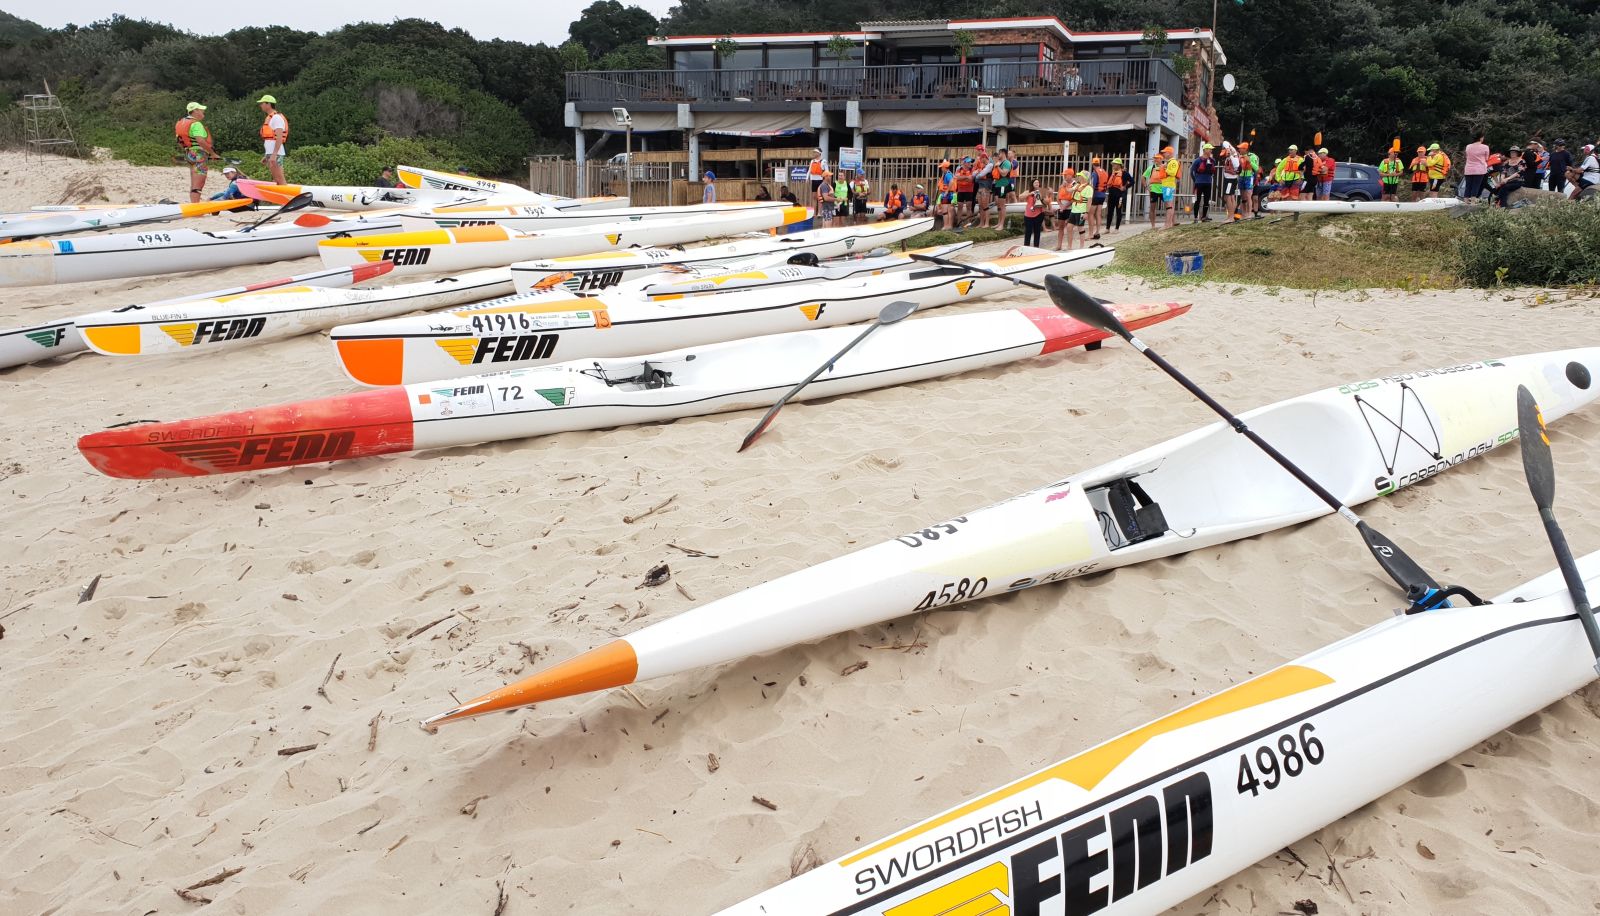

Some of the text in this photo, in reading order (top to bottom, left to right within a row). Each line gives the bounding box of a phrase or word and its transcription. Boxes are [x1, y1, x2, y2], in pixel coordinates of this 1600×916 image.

[137, 233, 172, 244] 4948
[381, 247, 432, 266] FENN
[192, 317, 267, 345] FENN
[472, 312, 530, 333] 41916
[472, 333, 560, 364] FENN
[453, 384, 485, 397] FENN
[498, 385, 525, 402] 72
[147, 424, 255, 442] SWORDFISH
[237, 431, 356, 466] FENN
[1398, 440, 1494, 488] CARBONOLOGY
[1040, 562, 1100, 583] PULSE
[912, 576, 988, 612] 4580
[1236, 721, 1326, 799] 4986
[853, 800, 1044, 896] SWORDFISH
[1010, 770, 1215, 916] FENN
